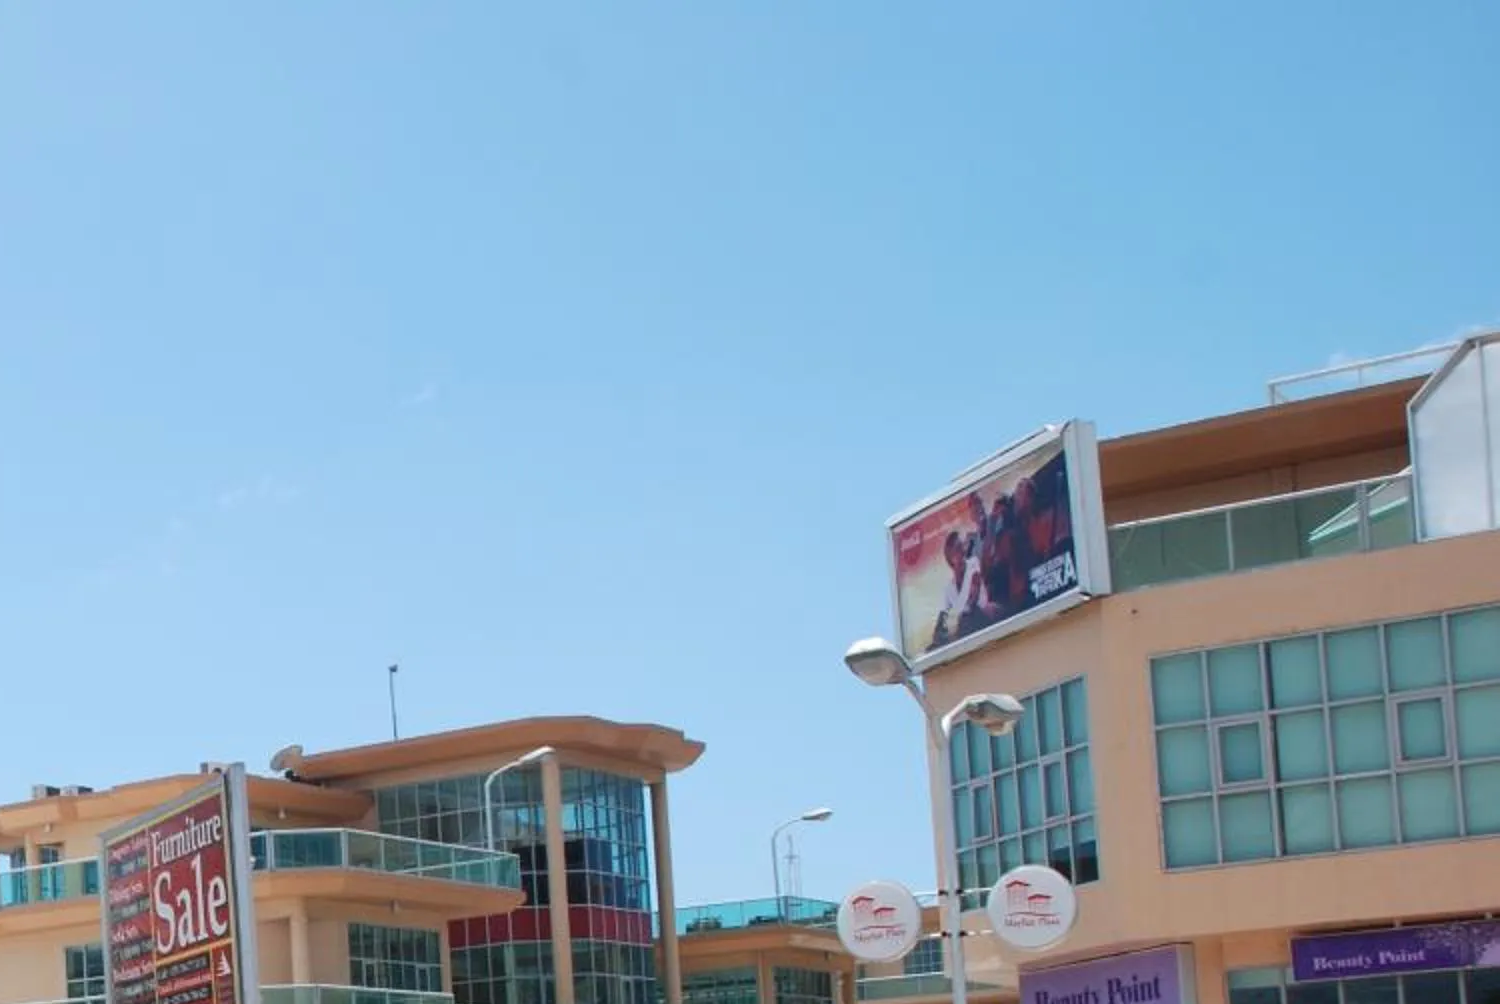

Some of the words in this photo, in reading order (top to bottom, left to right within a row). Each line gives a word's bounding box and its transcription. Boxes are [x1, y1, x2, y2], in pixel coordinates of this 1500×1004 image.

[151, 814, 222, 868] Furniture
[154, 854, 228, 954] Sale
[1312, 954, 1373, 970] Beauty
[1379, 948, 1425, 965] Point
